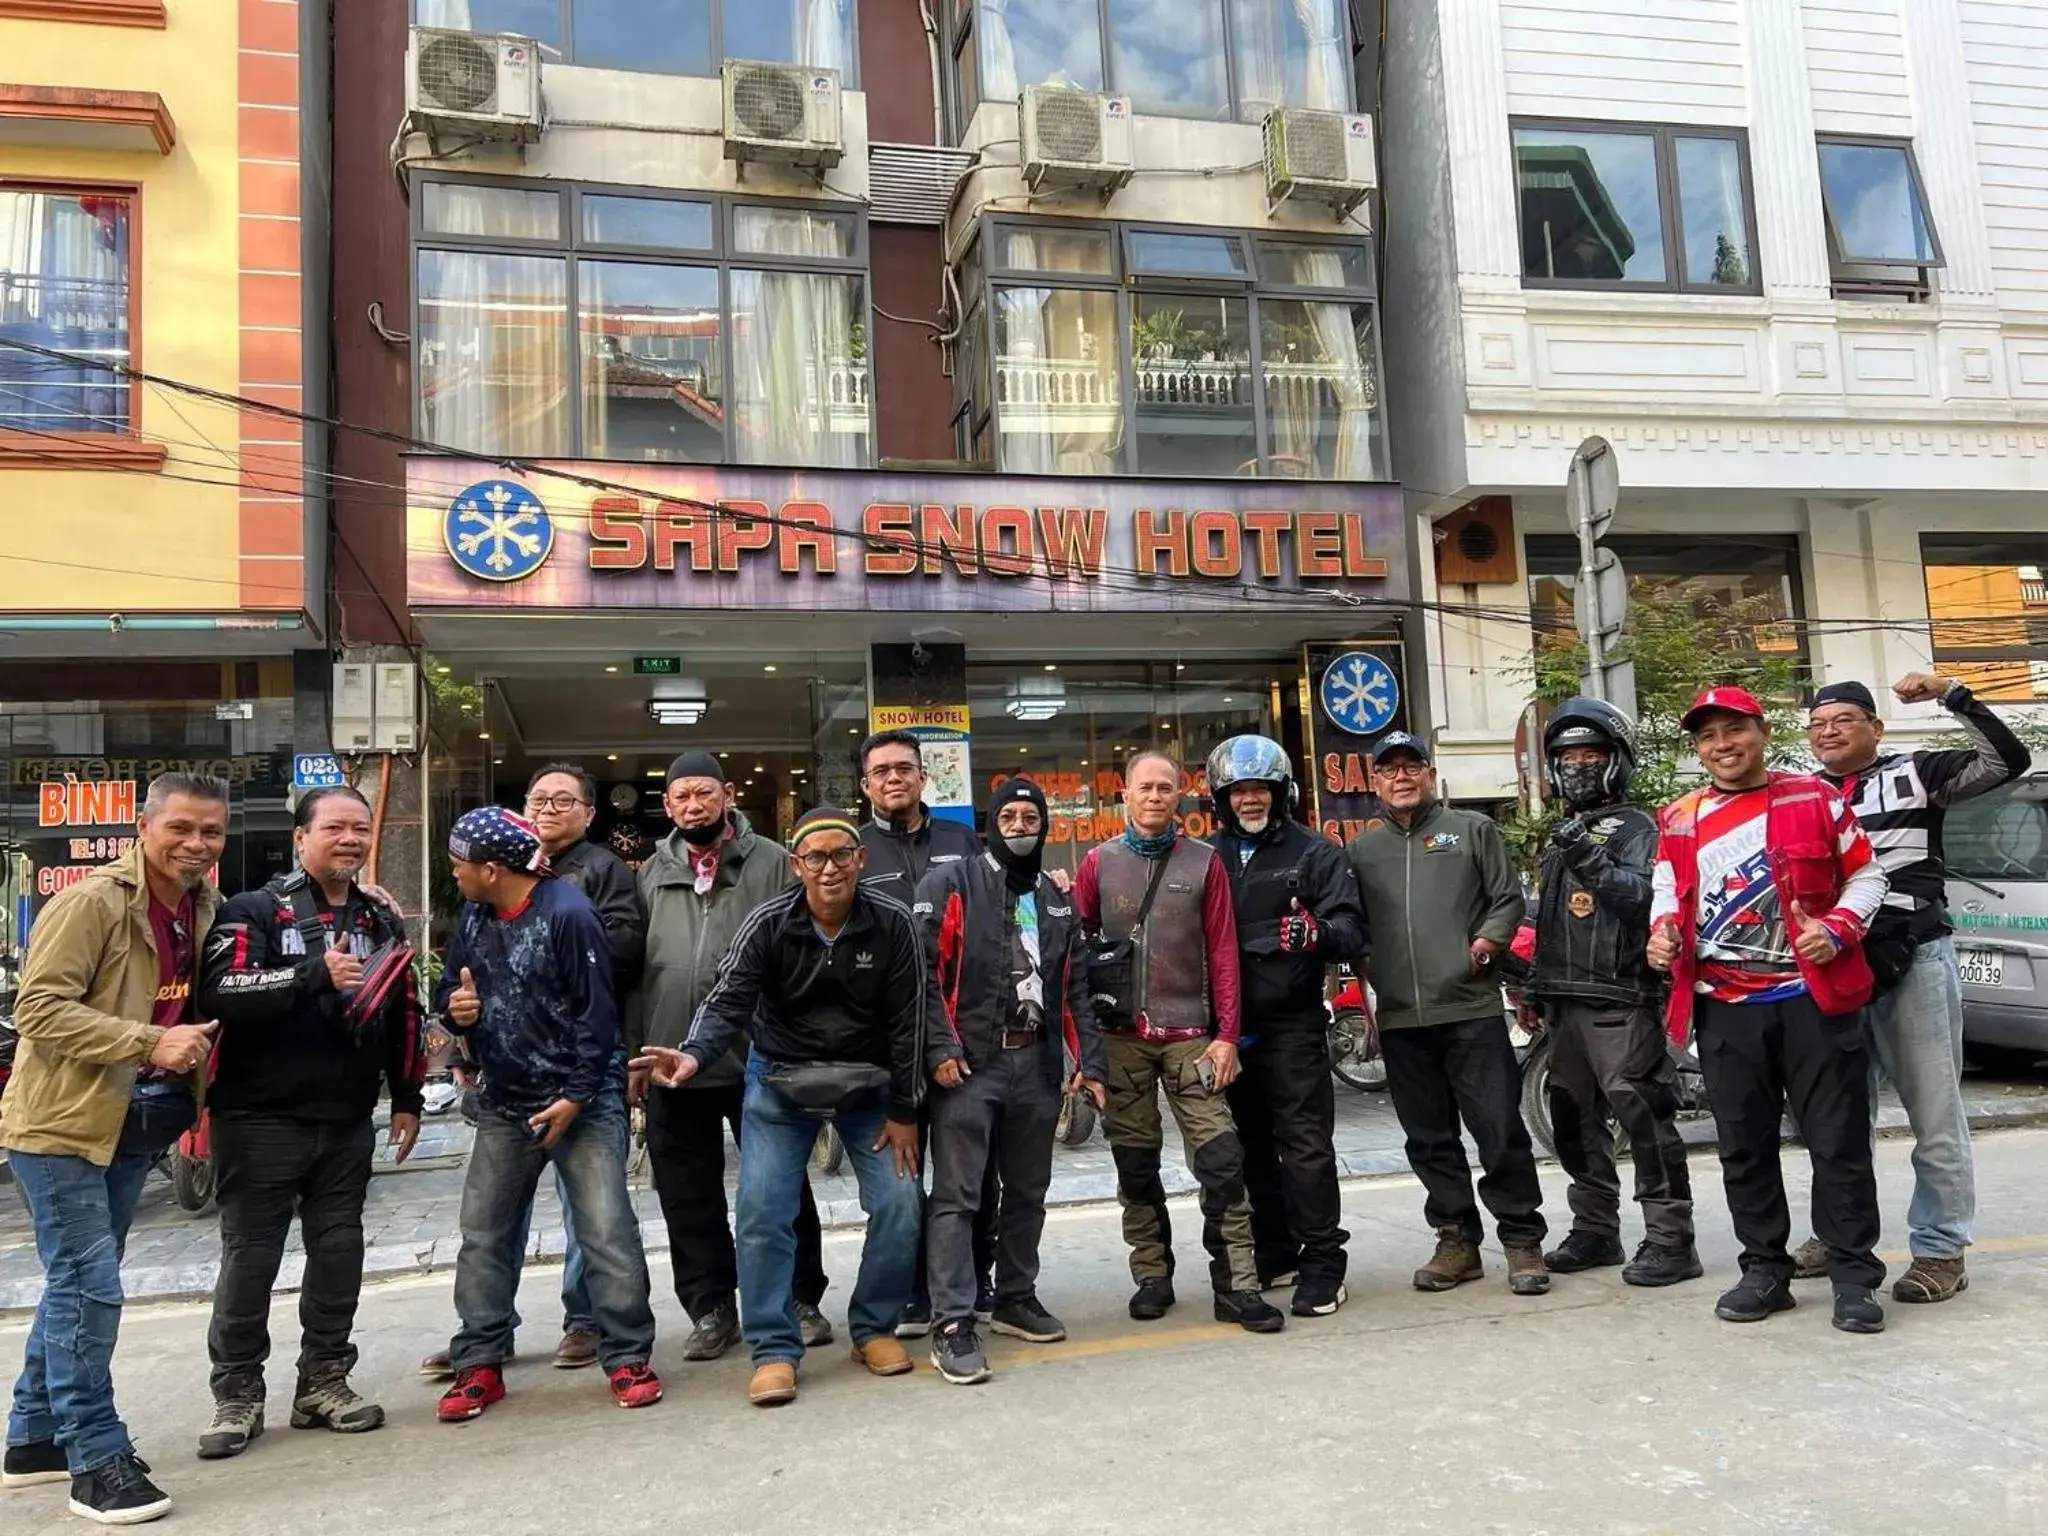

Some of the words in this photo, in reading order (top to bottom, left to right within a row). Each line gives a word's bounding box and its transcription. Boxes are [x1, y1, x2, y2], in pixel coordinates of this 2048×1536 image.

[589, 496, 837, 573] SAPA
[863, 503, 1108, 576] SNOW
[1136, 508, 1388, 577] HOTEL
[642, 659, 671, 667] EXIT
[879, 711, 920, 725] SNOW
[923, 710, 964, 724] HOTEL
[300, 757, 339, 775] 023
[39, 772, 136, 827] BÌNH
[1968, 951, 1992, 966] 24D
